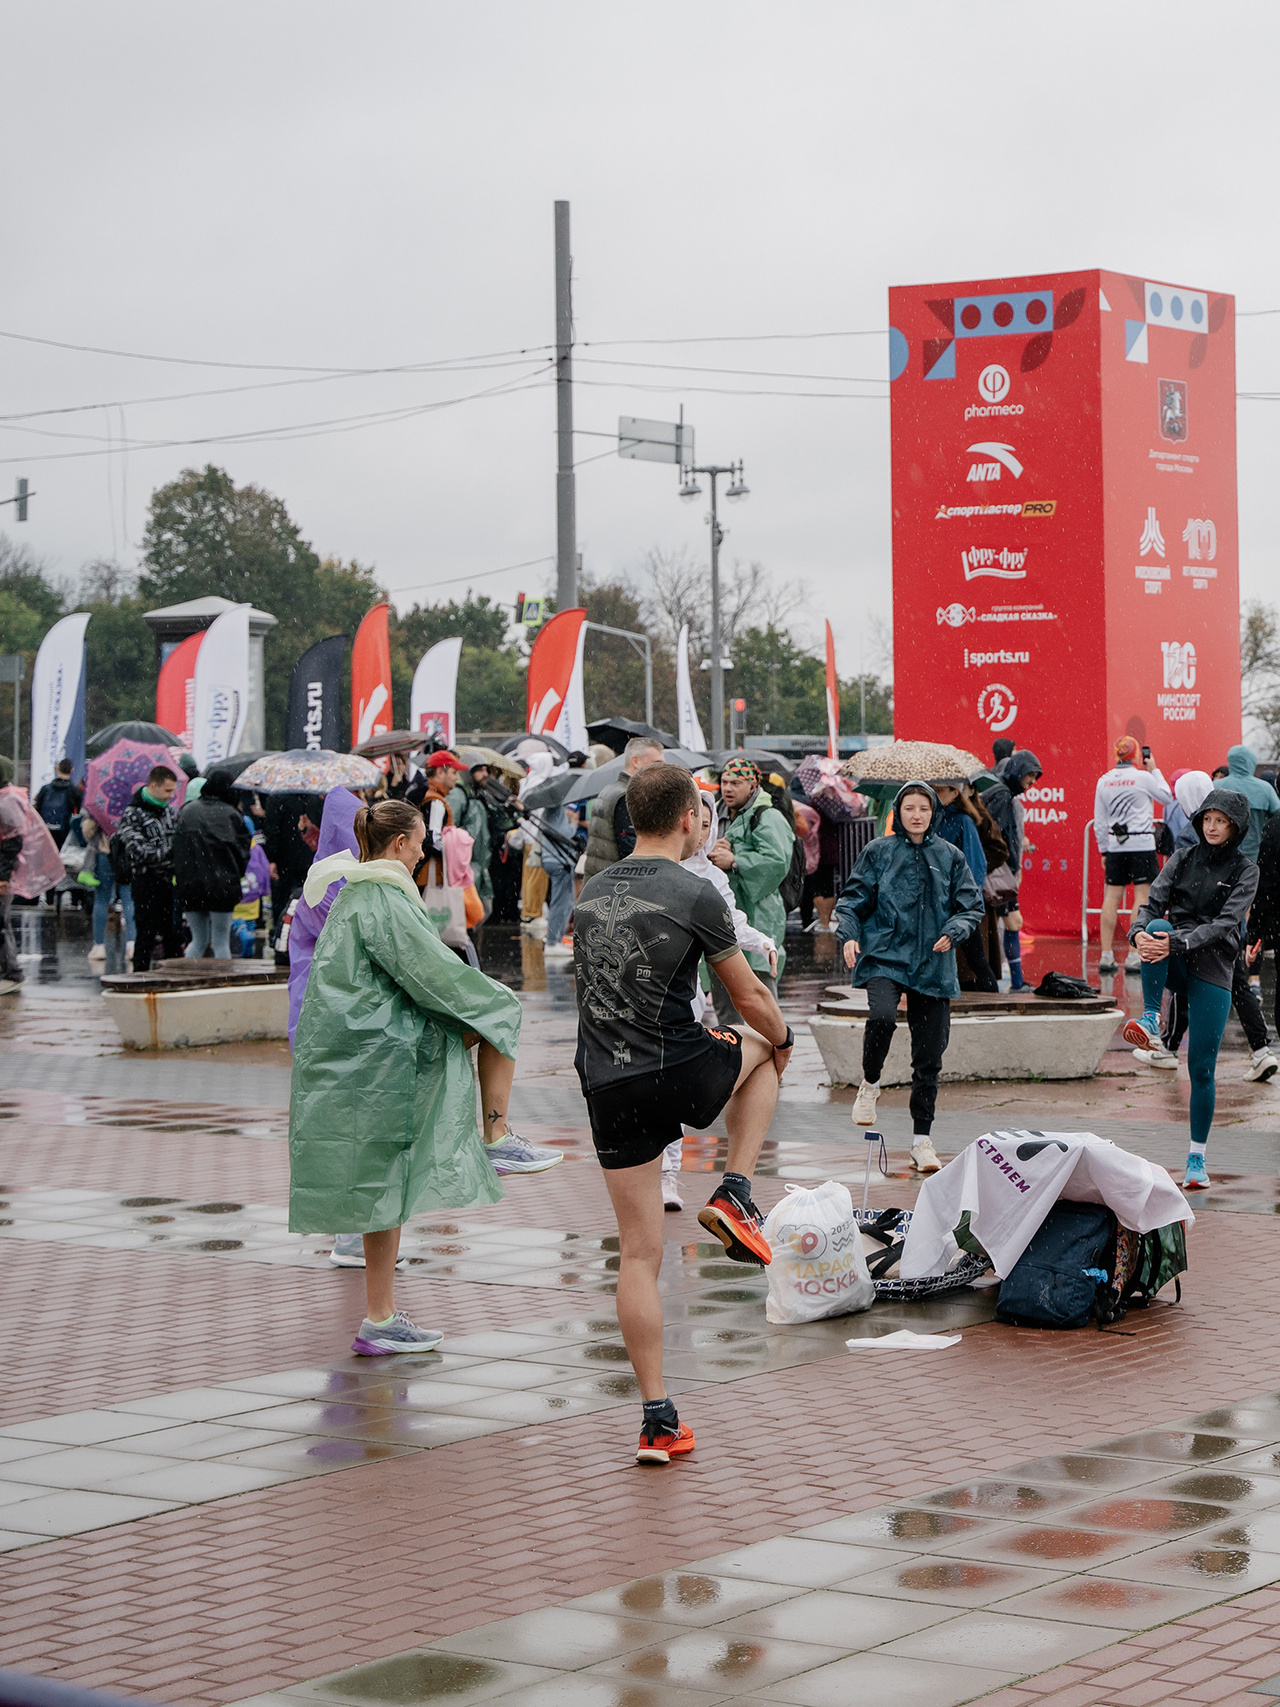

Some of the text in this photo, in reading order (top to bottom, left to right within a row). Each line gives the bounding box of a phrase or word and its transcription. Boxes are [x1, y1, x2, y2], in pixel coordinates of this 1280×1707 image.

[964, 404, 1024, 421] pharmeco
[966, 463, 1001, 482] ANTA
[1024, 503, 1053, 514] PRO
[968, 546, 1028, 569] фру-фру
[970, 649, 1029, 667] sports.ru
[977, 1138, 1031, 1193] СТВИЕМ
